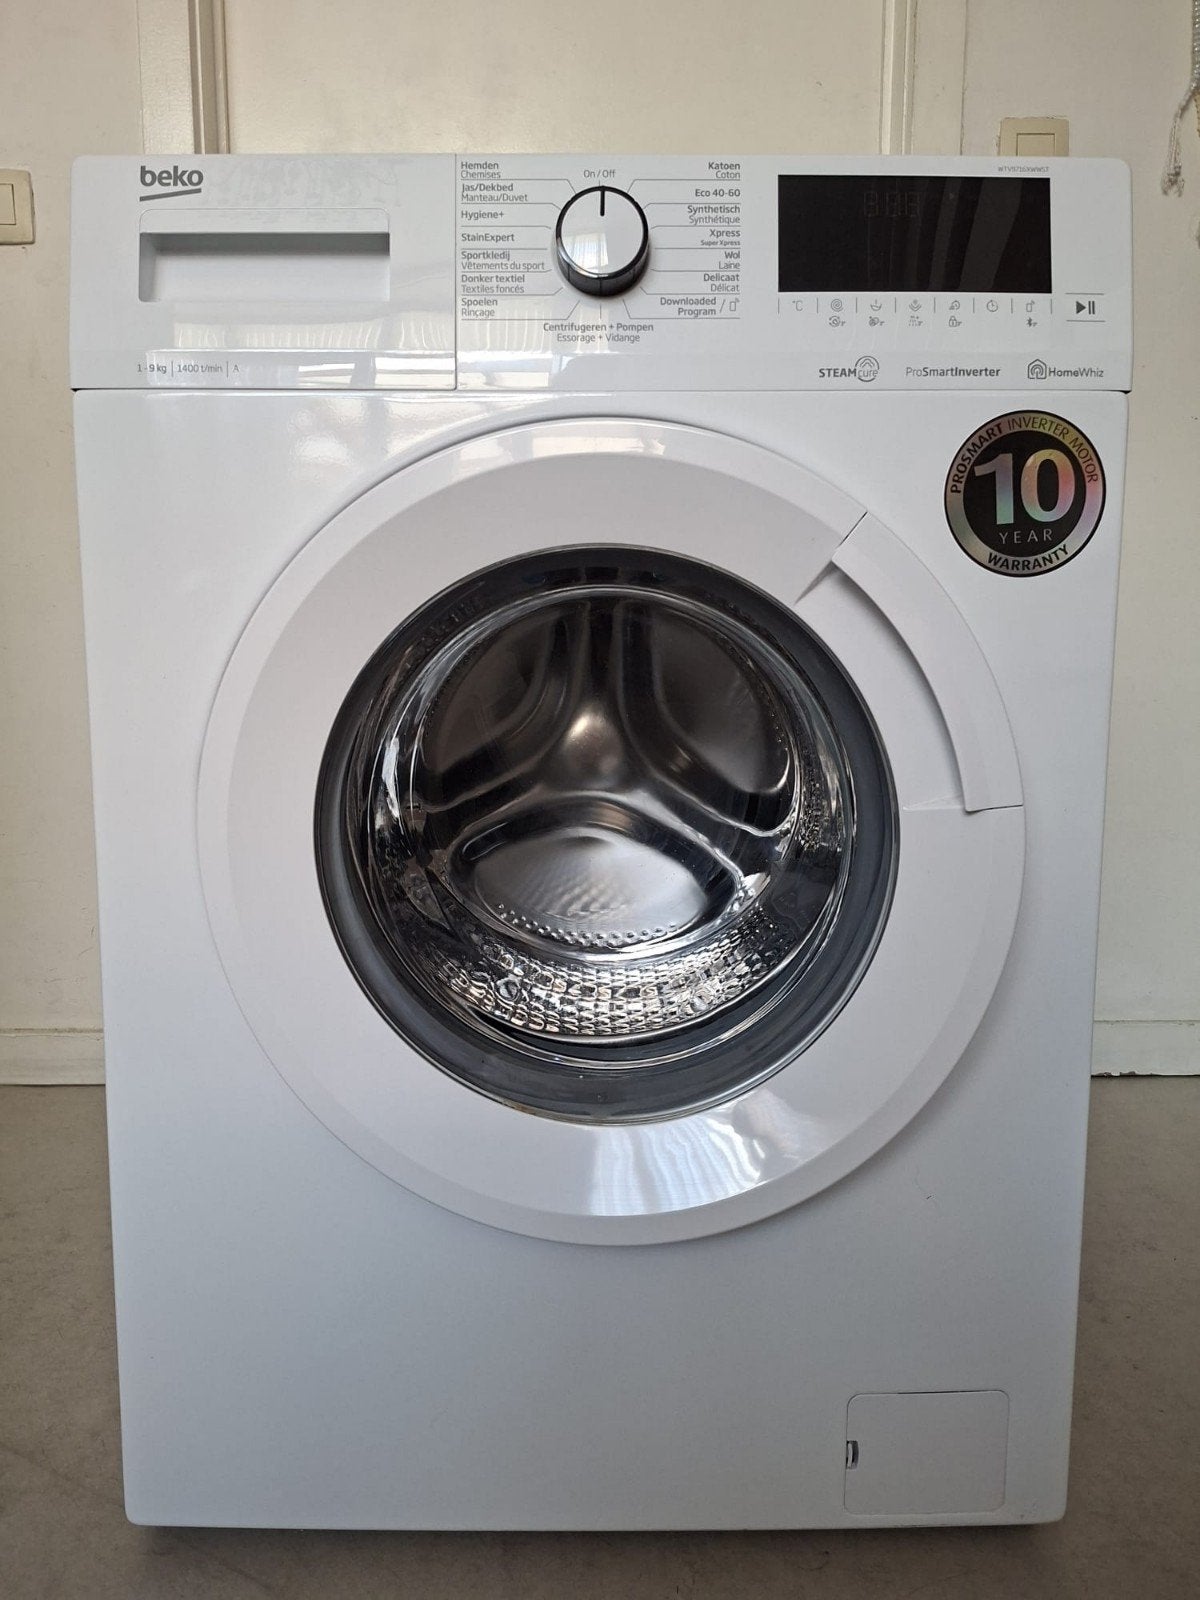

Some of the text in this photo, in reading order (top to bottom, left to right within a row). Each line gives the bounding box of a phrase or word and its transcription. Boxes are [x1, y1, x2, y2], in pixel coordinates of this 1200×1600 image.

[461, 162, 499, 170] Hemden
[708, 162, 741, 170] Katoen
[140, 165, 203, 187] beko
[461, 170, 501, 179] Chemises
[583, 170, 596, 178] On
[602, 169, 616, 178] Off
[715, 170, 740, 179] Coton
[462, 183, 514, 192] Jas/Dekbed
[461, 193, 528, 202] Manteau/Duvet
[695, 189, 741, 197] Eco 40-60
[687, 205, 740, 215] Synthetisch
[461, 210, 505, 220] Hygiene+
[689, 215, 740, 225] Synthétique
[461, 233, 515, 243] StainExpert
[709, 229, 741, 238] Xpress
[461, 251, 511, 260] Sportkledij
[724, 251, 740, 259] Wol
[461, 261, 545, 272] Vêtements du sport
[718, 261, 740, 269] Laine
[461, 274, 526, 283] Donker textiel
[703, 273, 740, 282] Delicaat
[461, 284, 525, 293] Textiles foncés
[710, 283, 740, 292] Délicat
[461, 298, 498, 307] Spoelen
[660, 297, 717, 306] Downloaded
[461, 308, 495, 318] Rinçage
[677, 308, 717, 318] Program
[543, 323, 607, 333] Centrifugeren
[616, 323, 654, 333] Pompen
[557, 334, 596, 343] Essorage
[605, 333, 640, 344] Vidange
[156, 364, 168, 374] kg
[177, 364, 223, 373] 1400 t/min
[232, 364, 240, 373] A
[905, 366, 1001, 377] ProSmartInverter
[1048, 366, 1104, 378] HomeWhiz
[950, 416, 1099, 494] PROSMART INVERTER MOTOR
[974, 449, 1076, 525] 10
[999, 529, 1053, 545] YEAR
[987, 544, 1070, 571] WARRANTY
